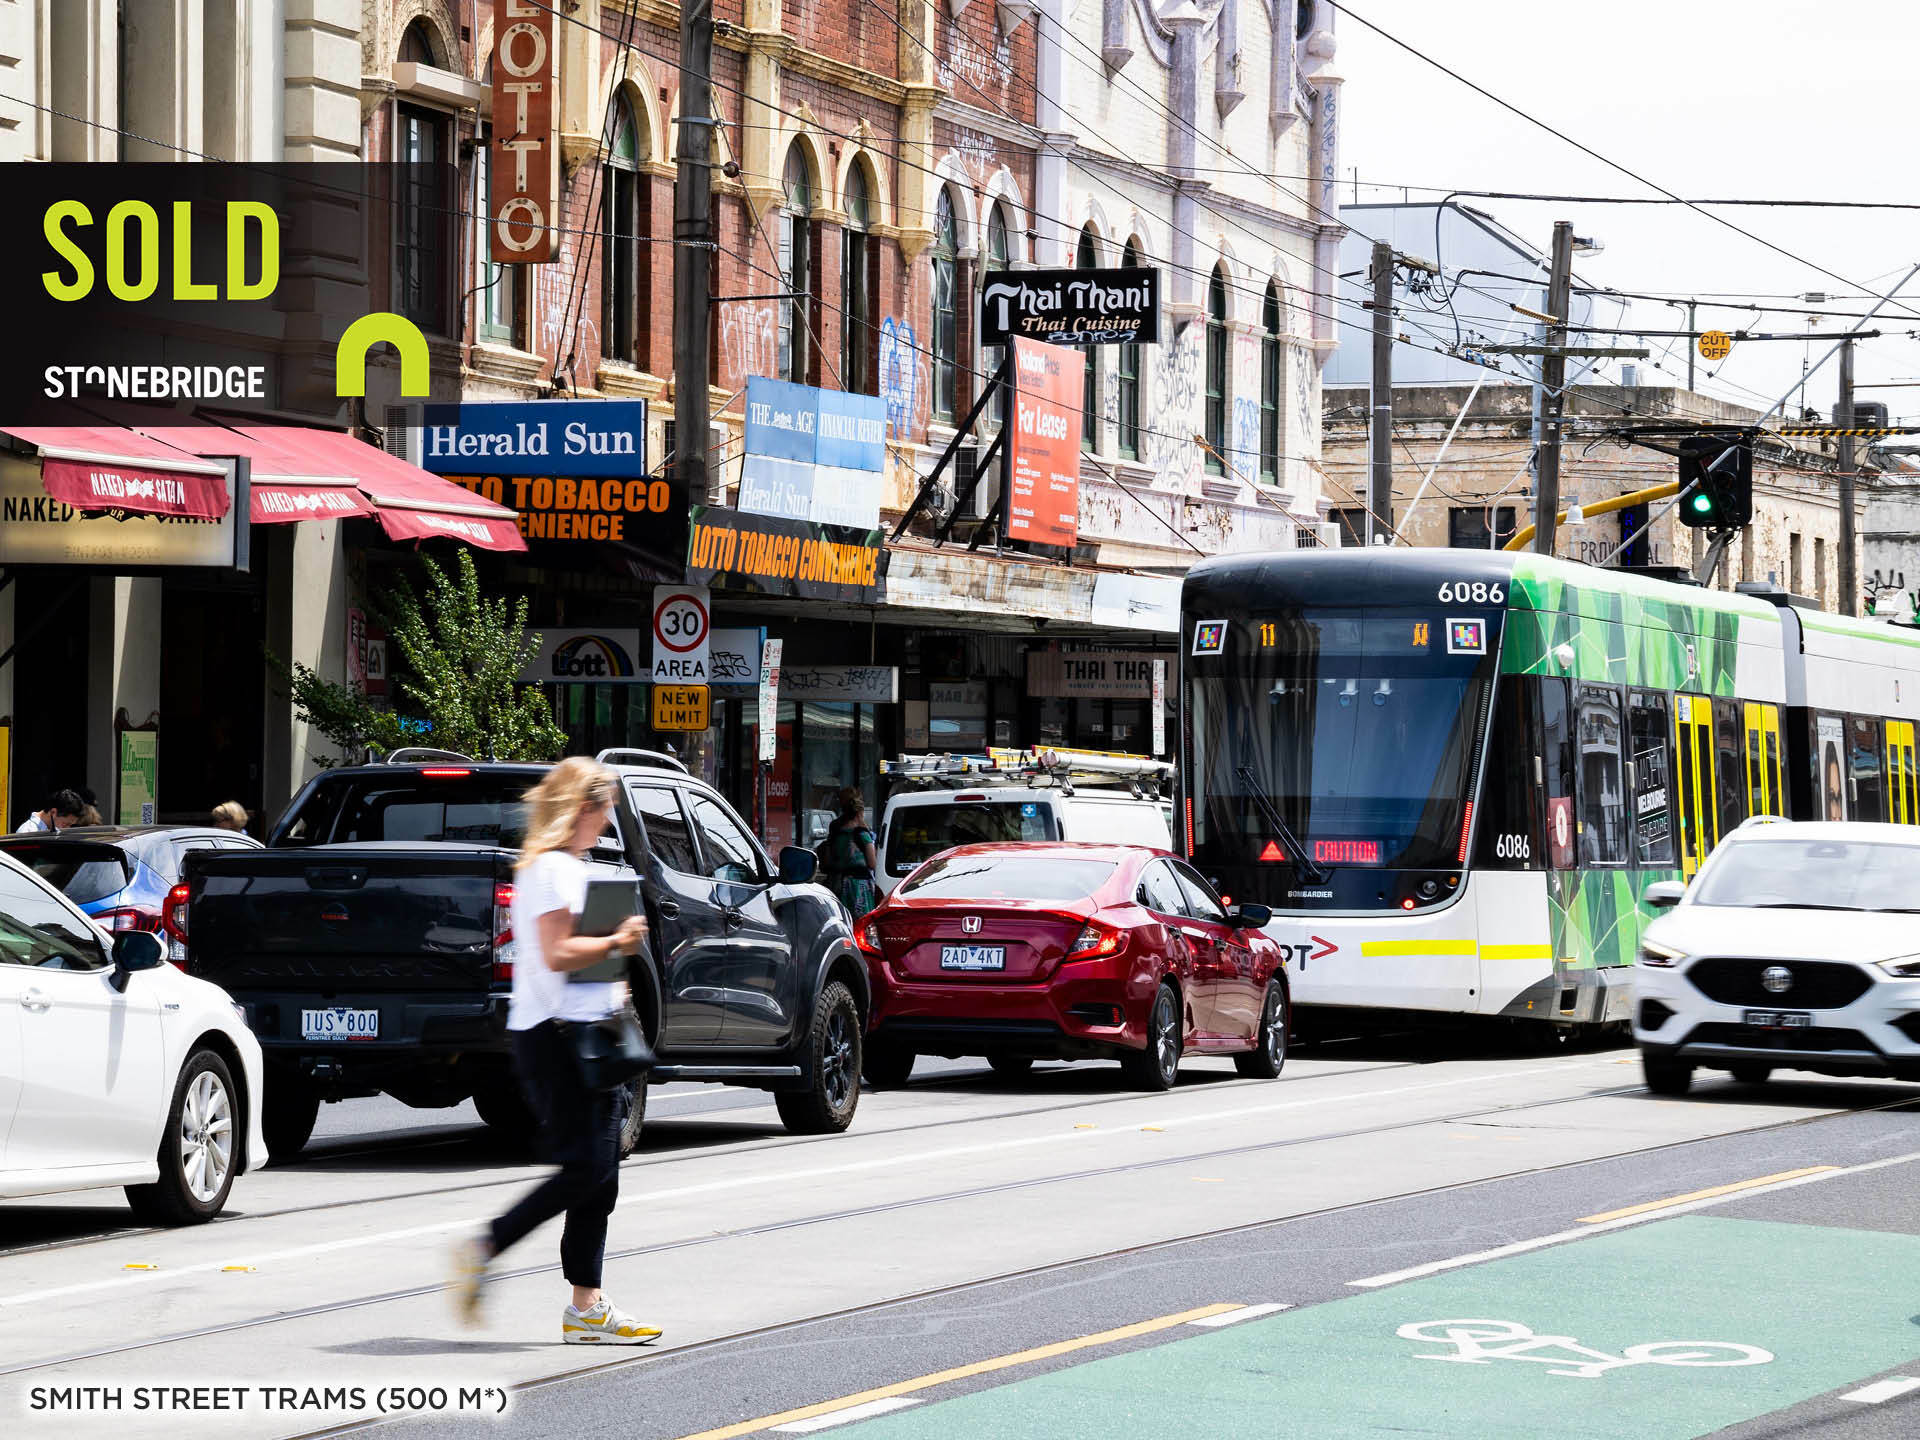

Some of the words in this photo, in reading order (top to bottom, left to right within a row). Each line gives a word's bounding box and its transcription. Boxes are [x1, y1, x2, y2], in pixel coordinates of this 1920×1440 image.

[984, 281, 1062, 331] Thai
[1067, 279, 1150, 315] Thani
[1021, 316, 1067, 332] Thai
[1072, 315, 1141, 334] Cuisine
[1700, 335, 1727, 346] CUT
[1702, 347, 1728, 358] OFF
[750, 402, 772, 427] THE
[794, 410, 816, 435] AGE
[820, 412, 856, 441] FINANCIAL
[857, 417, 883, 444] REVIEW
[1018, 401, 1035, 435] For
[1036, 404, 1068, 441] Lease
[428, 422, 550, 457] Herald
[564, 421, 637, 455] Sun
[90, 472, 125, 498] NAKED
[155, 477, 186, 505] SATAN
[511, 477, 671, 513] TOBACCO
[741, 477, 783, 513] Herald
[784, 482, 809, 517] Sun
[3, 496, 75, 522] NAKED
[259, 491, 295, 513] NAKED
[516, 512, 625, 541] ENIENCE
[691, 524, 738, 572] LOTTO
[737, 530, 800, 579] TOBACCO
[799, 538, 879, 587] CONVENIENCE
[1438, 581, 1505, 603] 6086
[664, 610, 699, 636] 30
[1260, 623, 1276, 647] 11
[551, 654, 606, 677] Lott
[655, 659, 706, 678] AREA
[1063, 660, 1106, 680] THAI
[1113, 660, 1169, 680] THAI
[662, 692, 700, 705] NEW
[660, 710, 702, 724] LIMIT
[767, 777, 790, 798] Lease
[1314, 840, 1378, 863] CAUTION
[1496, 833, 1530, 859] 6086
[1287, 890, 1333, 898] BOMBARDIER
[943, 949, 968, 963] 2AD
[977, 949, 1002, 963] 4KT
[306, 1013, 334, 1031] 1US
[347, 1013, 377, 1031] 800
